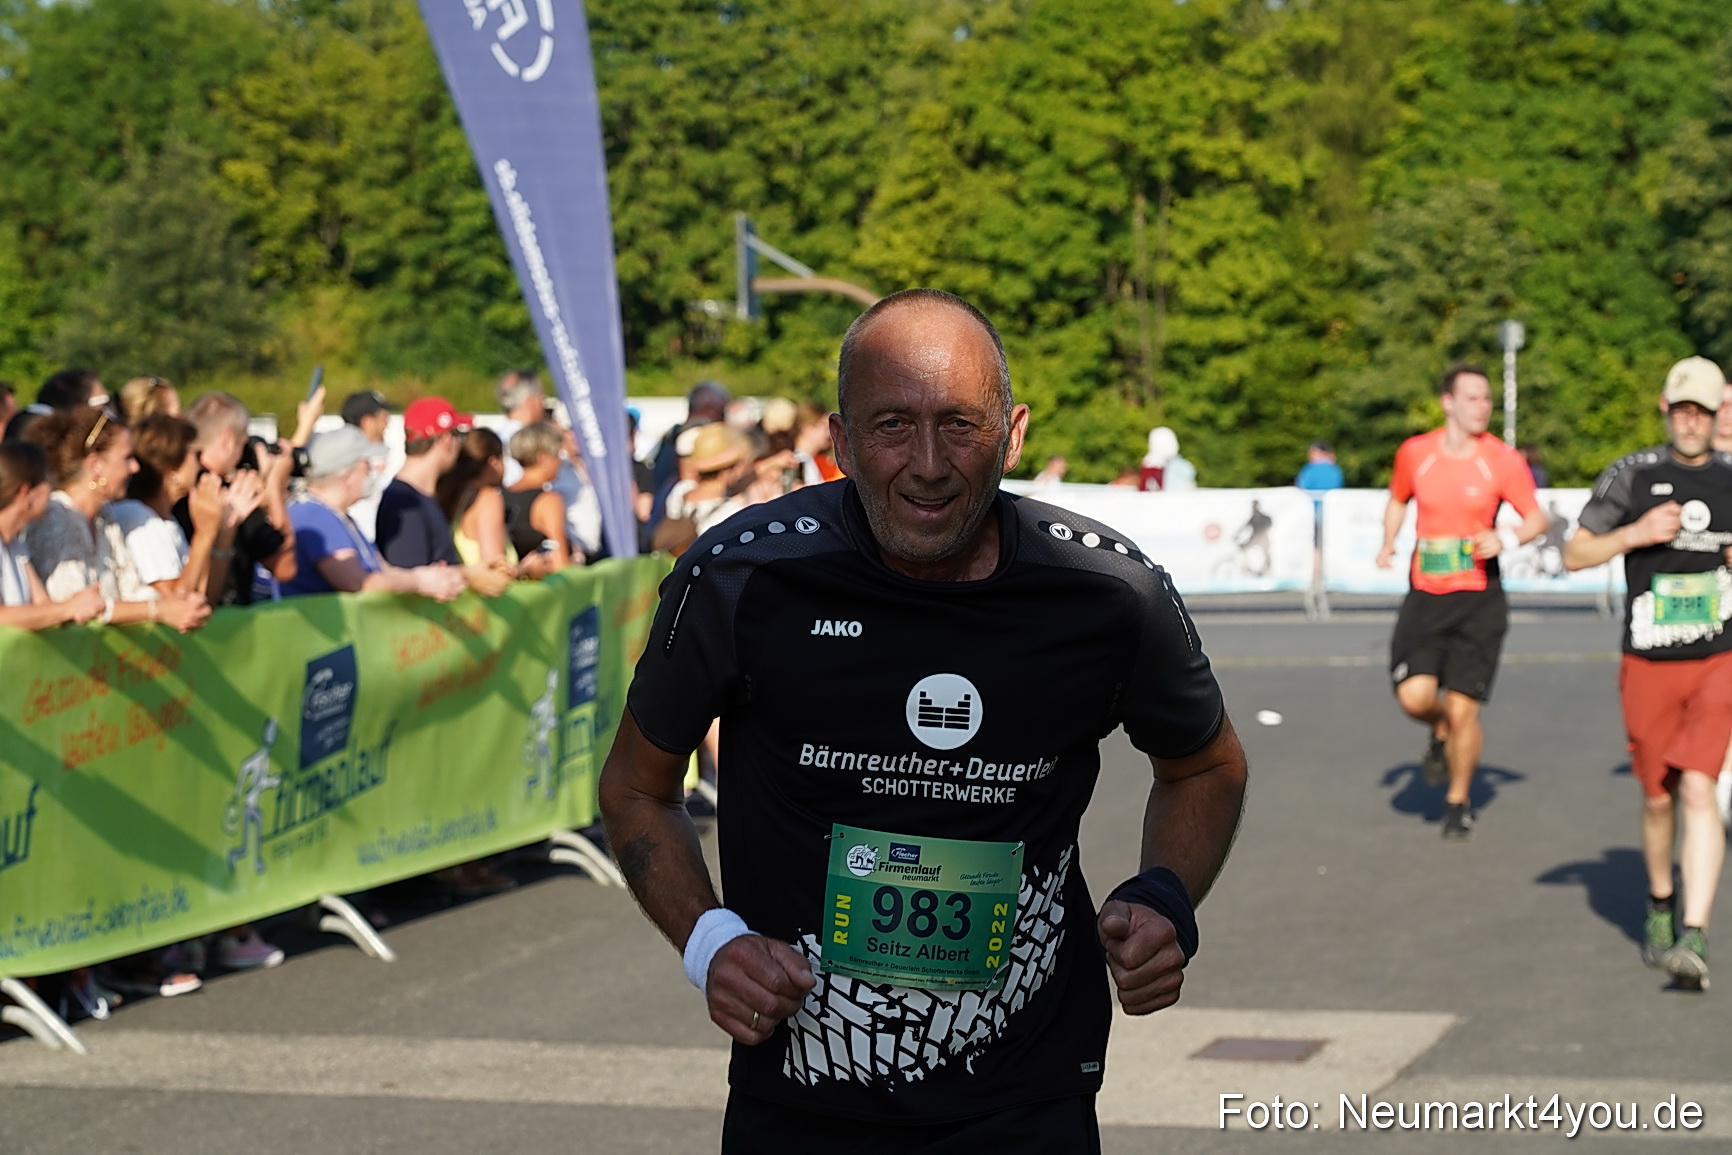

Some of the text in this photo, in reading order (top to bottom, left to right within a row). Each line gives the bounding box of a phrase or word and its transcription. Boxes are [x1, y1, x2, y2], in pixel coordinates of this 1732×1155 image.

[811, 619, 863, 638] JAKO
[798, 742, 1059, 783] Bärnreuther+Deuerlei
[861, 777, 1017, 804] SCHOTTERWERKE
[878, 861, 942, 876] Firmenlauf
[901, 874, 940, 882] neumarkt
[833, 894, 852, 945] RUN
[871, 885, 972, 941] 983
[866, 936, 971, 962] Seitz Albert
[985, 902, 1009, 969] 2022
